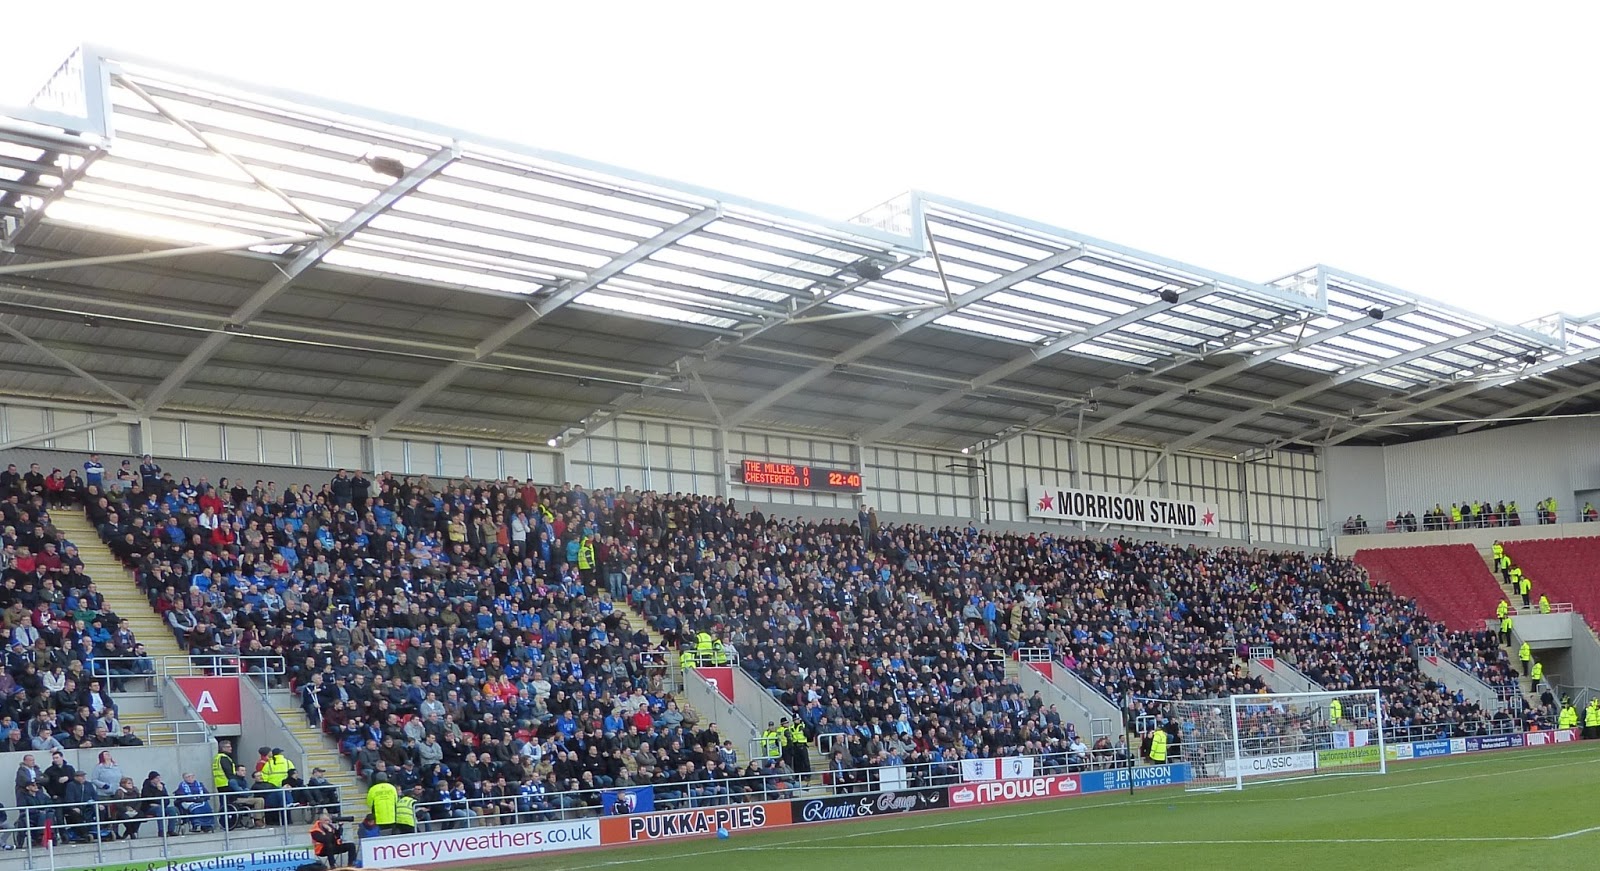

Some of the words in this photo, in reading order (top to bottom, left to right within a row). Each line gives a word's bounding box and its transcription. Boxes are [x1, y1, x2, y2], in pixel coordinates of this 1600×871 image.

[745, 462, 761, 472] THE
[764, 463, 796, 475] MILLERS
[803, 467, 809, 476] 0
[745, 472, 800, 486] CHESTERFIELD
[803, 478, 810, 486] 0
[829, 473, 860, 486] 22:40
[1057, 491, 1145, 522] MORRISON
[1150, 500, 1197, 526] STAND
[196, 690, 218, 712] A
[1253, 757, 1292, 770] CLASSIC
[1318, 748, 1380, 761] bartonrealestates.co.
[1116, 766, 1171, 782] JENKINSON
[1117, 777, 1172, 789] inurance
[977, 777, 1055, 802] npower
[802, 800, 856, 821] Renoirs
[857, 797, 874, 816] &
[629, 805, 765, 840] PUKKA-PIES
[373, 824, 593, 860] merryweathers.co.uk
[167, 856, 246, 871] Recycling
[250, 847, 310, 866] Limited
